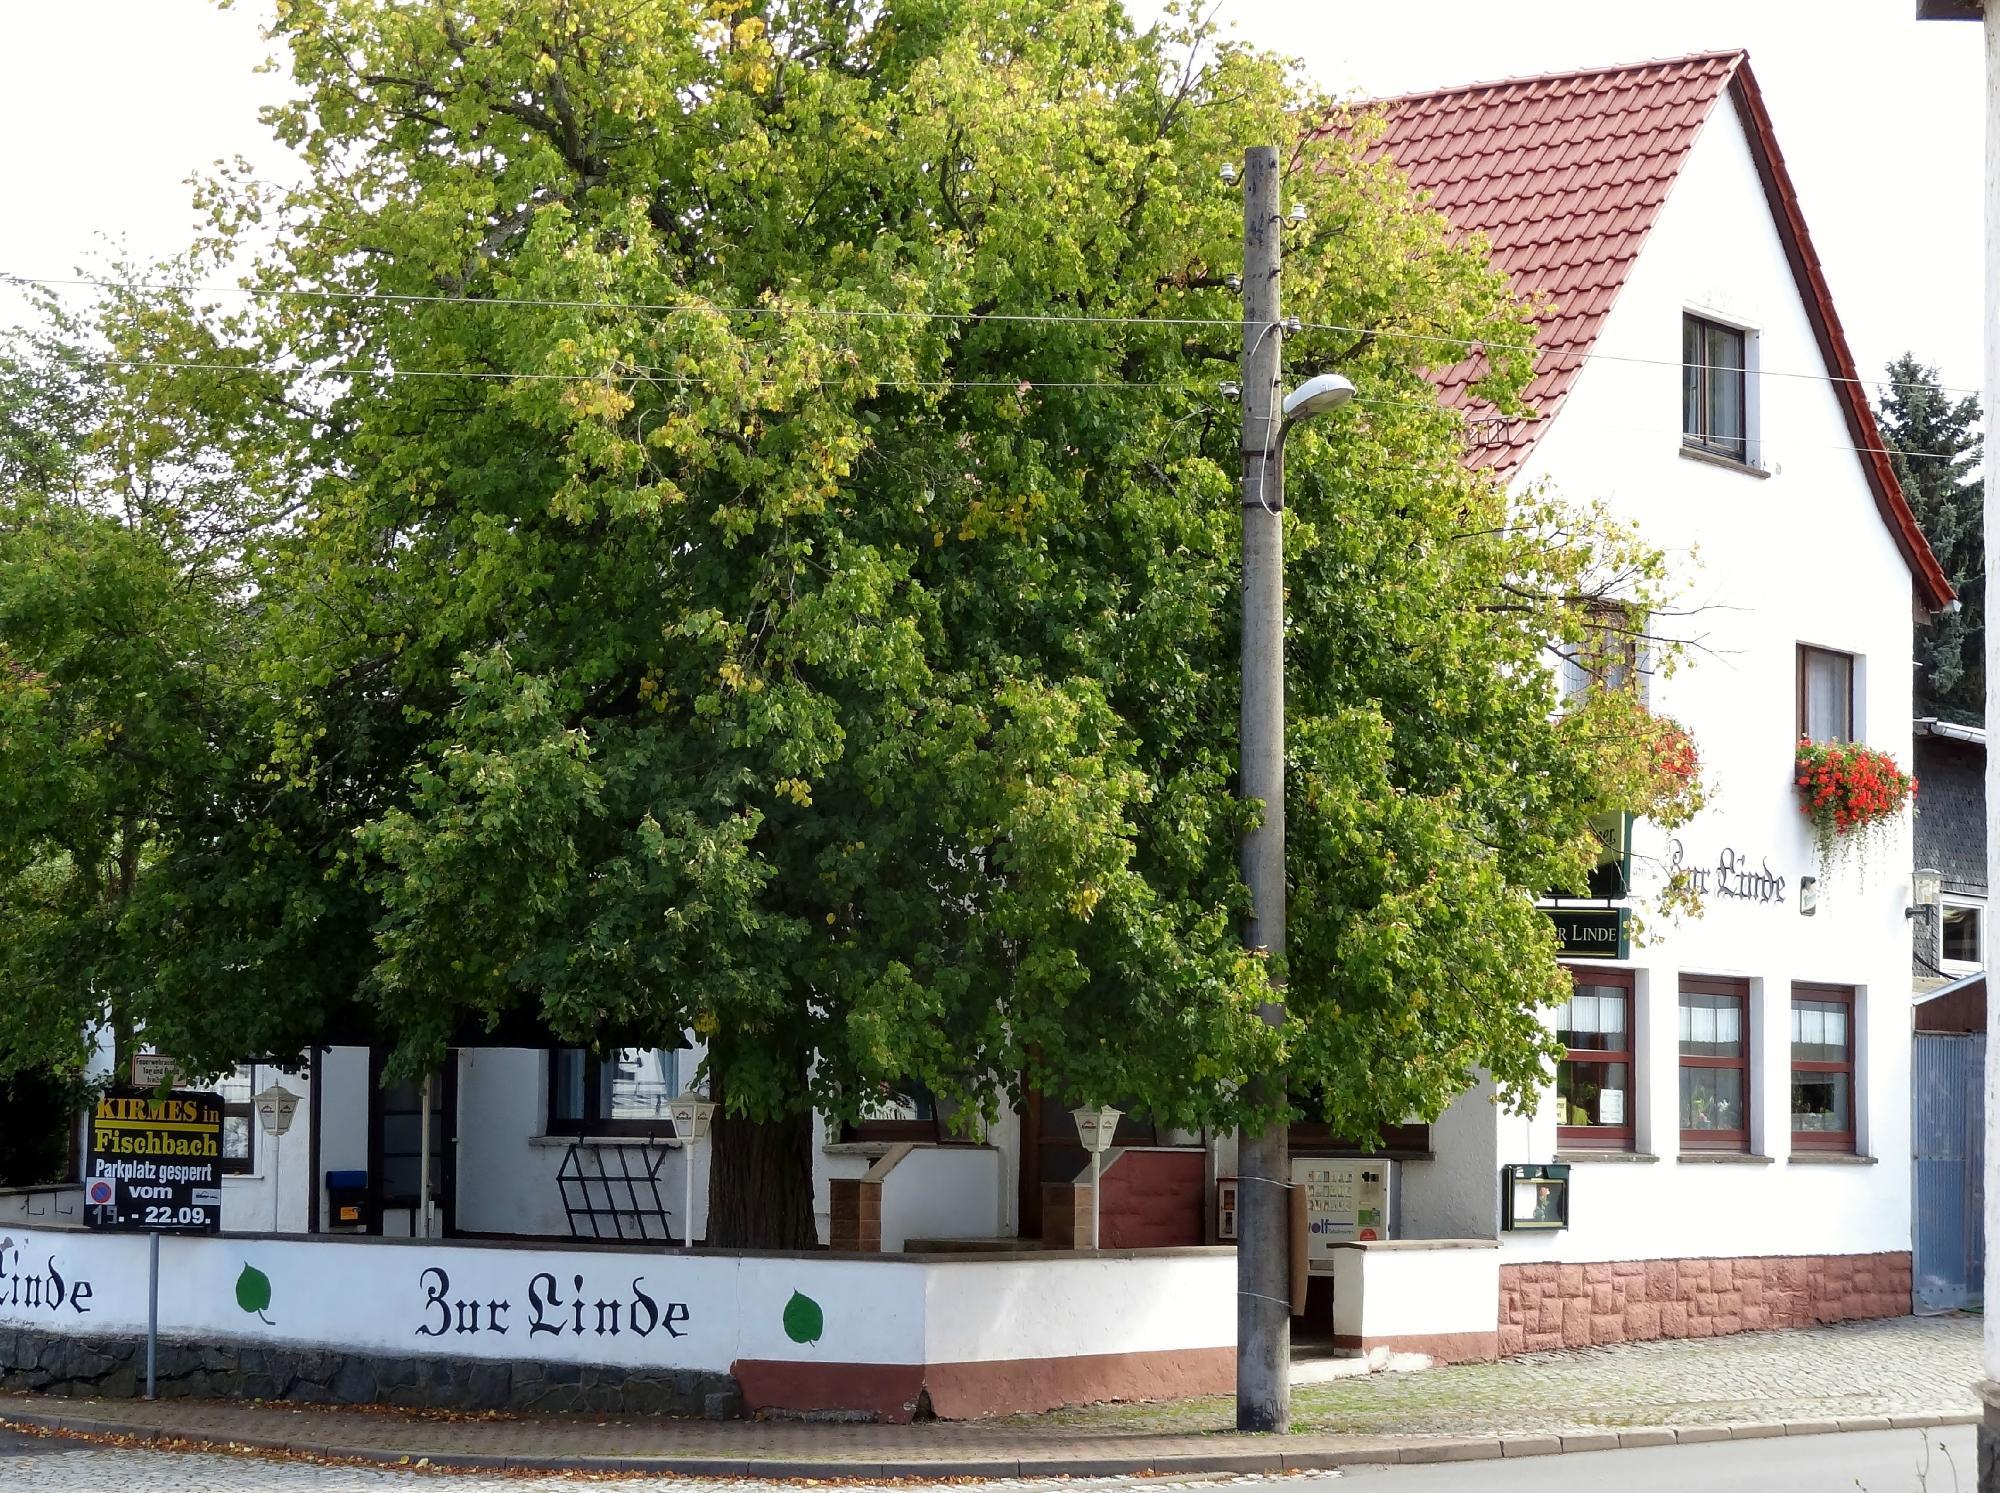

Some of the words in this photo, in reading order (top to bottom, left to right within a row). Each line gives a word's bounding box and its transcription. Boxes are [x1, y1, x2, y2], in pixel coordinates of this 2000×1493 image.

[1716, 847, 1787, 905] Linde
[1572, 923, 1617, 942] LINDE
[96, 1098, 198, 1122] KIRMES
[203, 1105, 220, 1123] in
[94, 1128, 218, 1156] Fischbach
[95, 1158, 157, 1182] Parkplatz
[159, 1163, 212, 1184] gesperrt
[128, 1185, 173, 1199] vom
[144, 1206, 211, 1224] 22.09.
[415, 1266, 511, 1337] Zur
[528, 1272, 690, 1340] Linde
